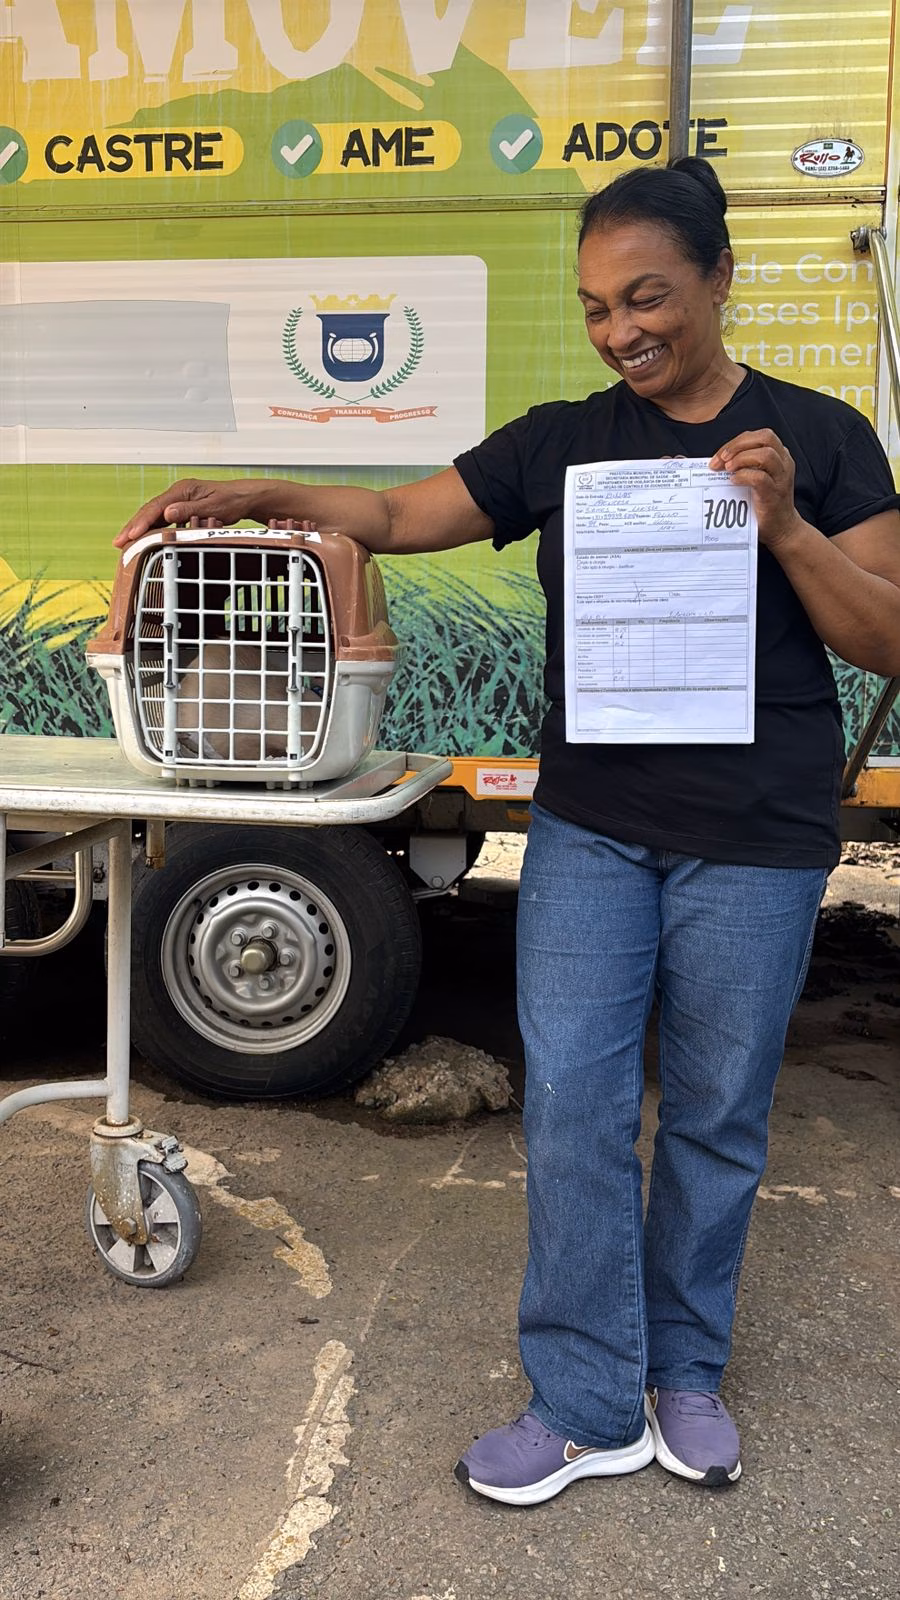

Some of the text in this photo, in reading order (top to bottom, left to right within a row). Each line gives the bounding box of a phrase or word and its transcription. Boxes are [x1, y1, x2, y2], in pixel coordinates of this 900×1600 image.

[44, 131, 224, 174] CASTRE
[340, 126, 435, 168] AME
[562, 117, 728, 162] ADOE
[277, 409, 318, 422] CONFIANÇA
[389, 409, 431, 421] PROGRESSO
[704, 499, 748, 530] 7000
